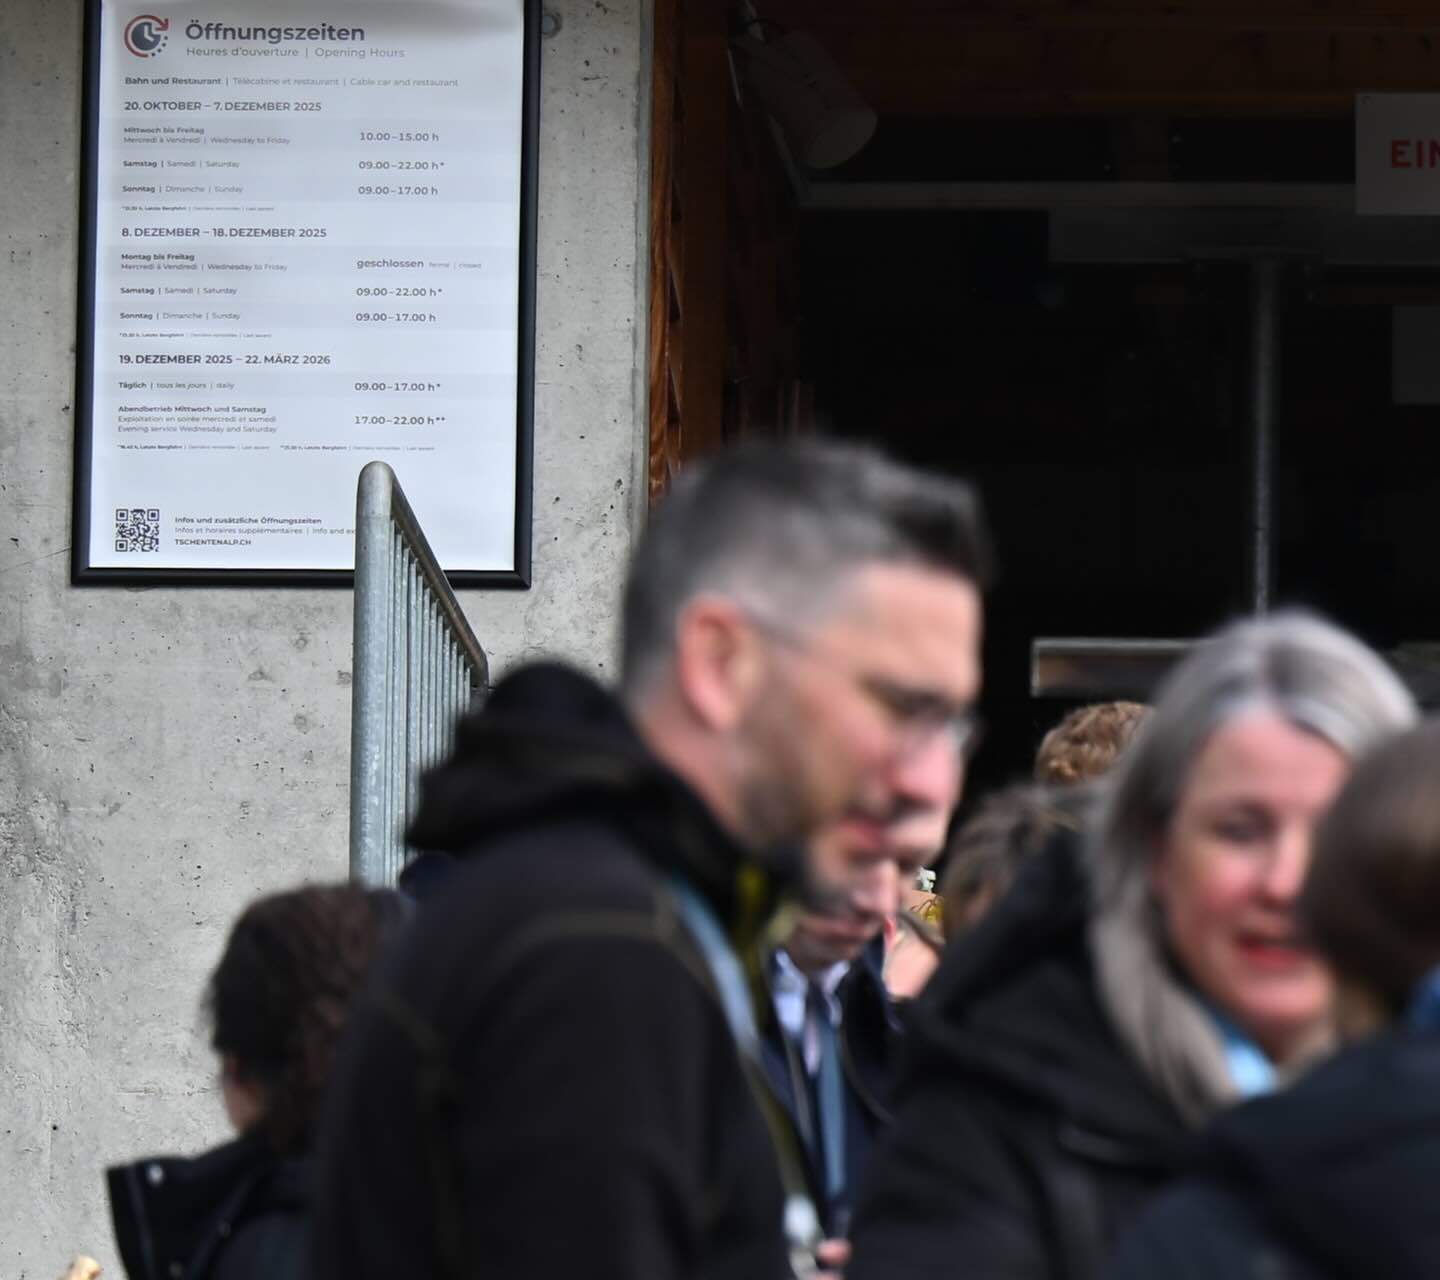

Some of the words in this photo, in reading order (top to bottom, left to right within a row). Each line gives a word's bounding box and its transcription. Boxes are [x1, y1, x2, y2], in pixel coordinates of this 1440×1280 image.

[185, 18, 366, 45] Öffnungszeiten
[187, 47, 228, 57] Heures
[315, 47, 366, 59] Opening
[370, 48, 406, 58] Hours
[125, 77, 149, 85] Bahn
[152, 77, 170, 85] und
[172, 77, 221, 85] Restaurant
[124, 101, 141, 111] 20.
[143, 101, 201, 111] OKTOBER
[214, 102, 223, 111] 7.
[225, 102, 290, 112] DEZEMBER
[294, 103, 322, 112] 2025
[123, 160, 157, 169] Samstag
[122, 185, 155, 194] Sonntag
[121, 228, 132, 237] 8.
[134, 228, 200, 237] DEZEMBER
[212, 228, 228, 237] 18.
[229, 228, 296, 238] DEZEMBER
[299, 229, 327, 238] 2025
[121, 253, 151, 262] Montag
[167, 253, 195, 261] Freitag
[356, 260, 424, 269] geschlossen
[120, 287, 155, 295] Samstag
[120, 312, 153, 320] Sonntag
[119, 355, 134, 364] 19.
[136, 355, 201, 364] DEZEMBER
[205, 355, 232, 364] 2025
[245, 355, 262, 364] 22.
[264, 353, 299, 364] MÄRZ
[303, 355, 331, 364] 2026
[119, 382, 147, 390] Täglich
[232, 406, 266, 414] Samstag
[261, 516, 322, 526] Öffnungszeiten
